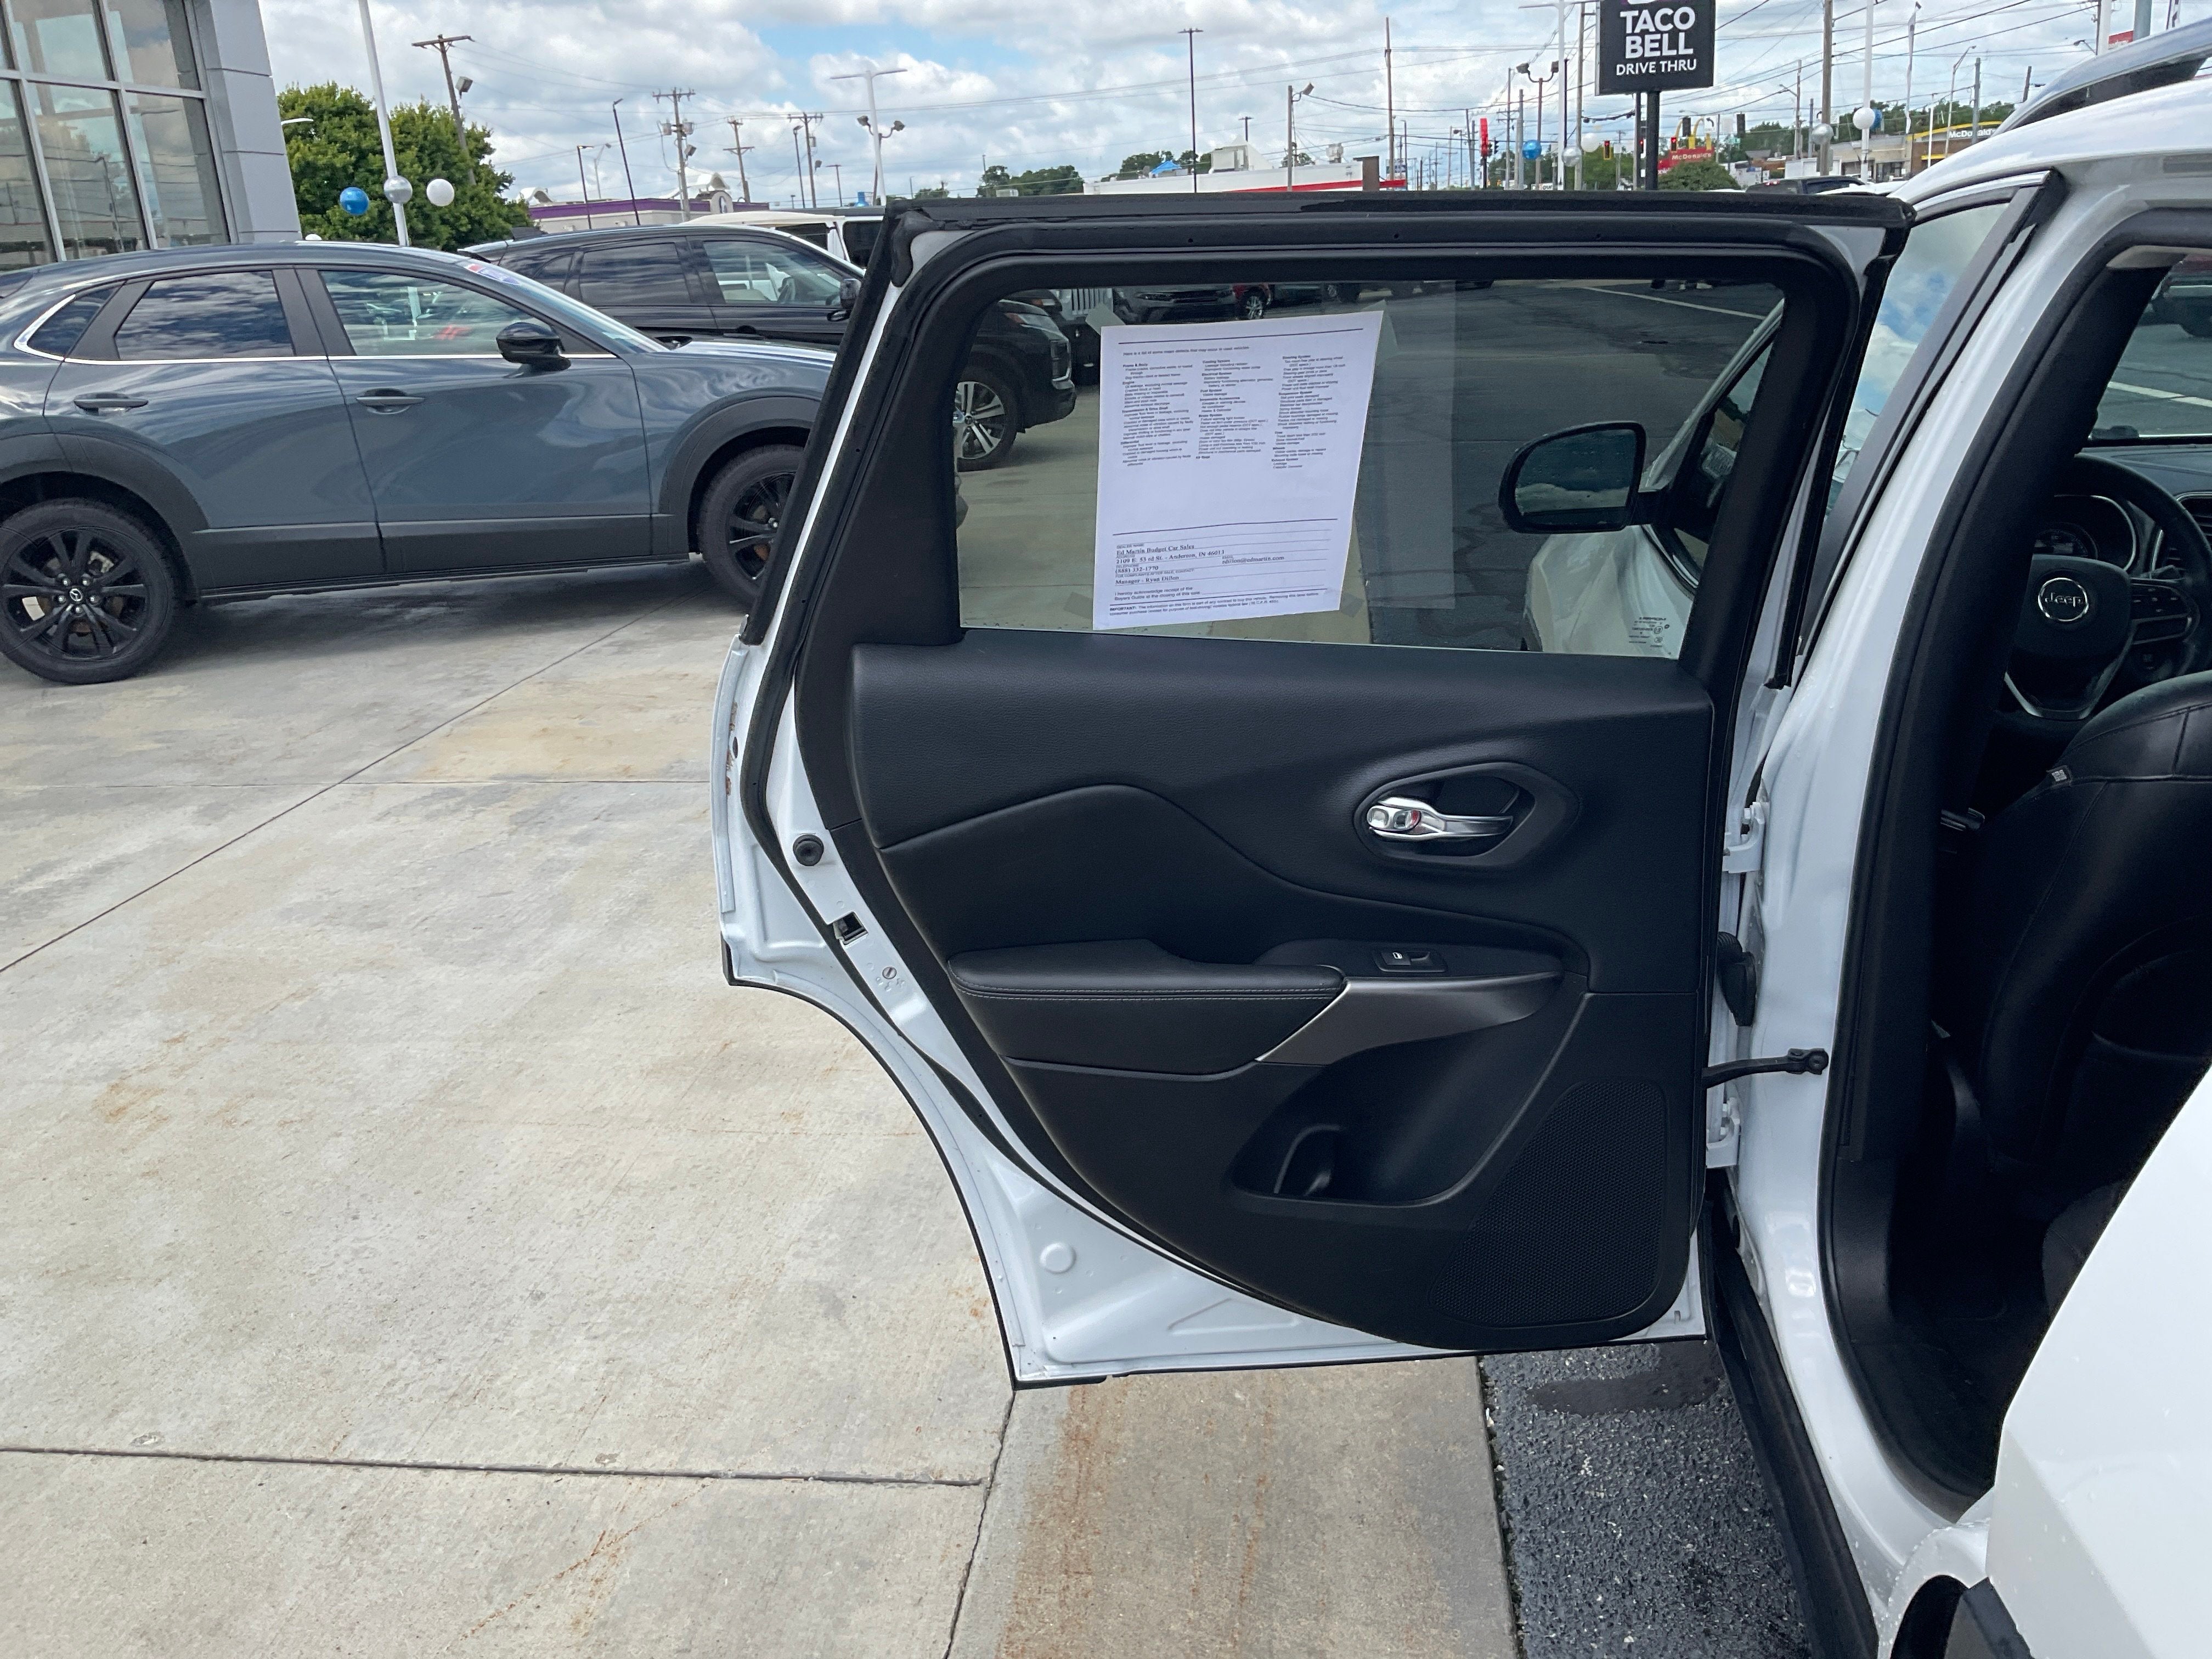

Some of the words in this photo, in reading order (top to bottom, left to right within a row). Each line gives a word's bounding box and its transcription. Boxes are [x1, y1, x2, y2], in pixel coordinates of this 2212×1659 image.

[1620, 6, 1696, 34] TACO
[1625, 32, 1694, 59] BELL
[1616, 61, 1657, 76] DRIVE
[1659, 58, 1697, 73] THRU
[2045, 592, 2084, 607] Jeep
